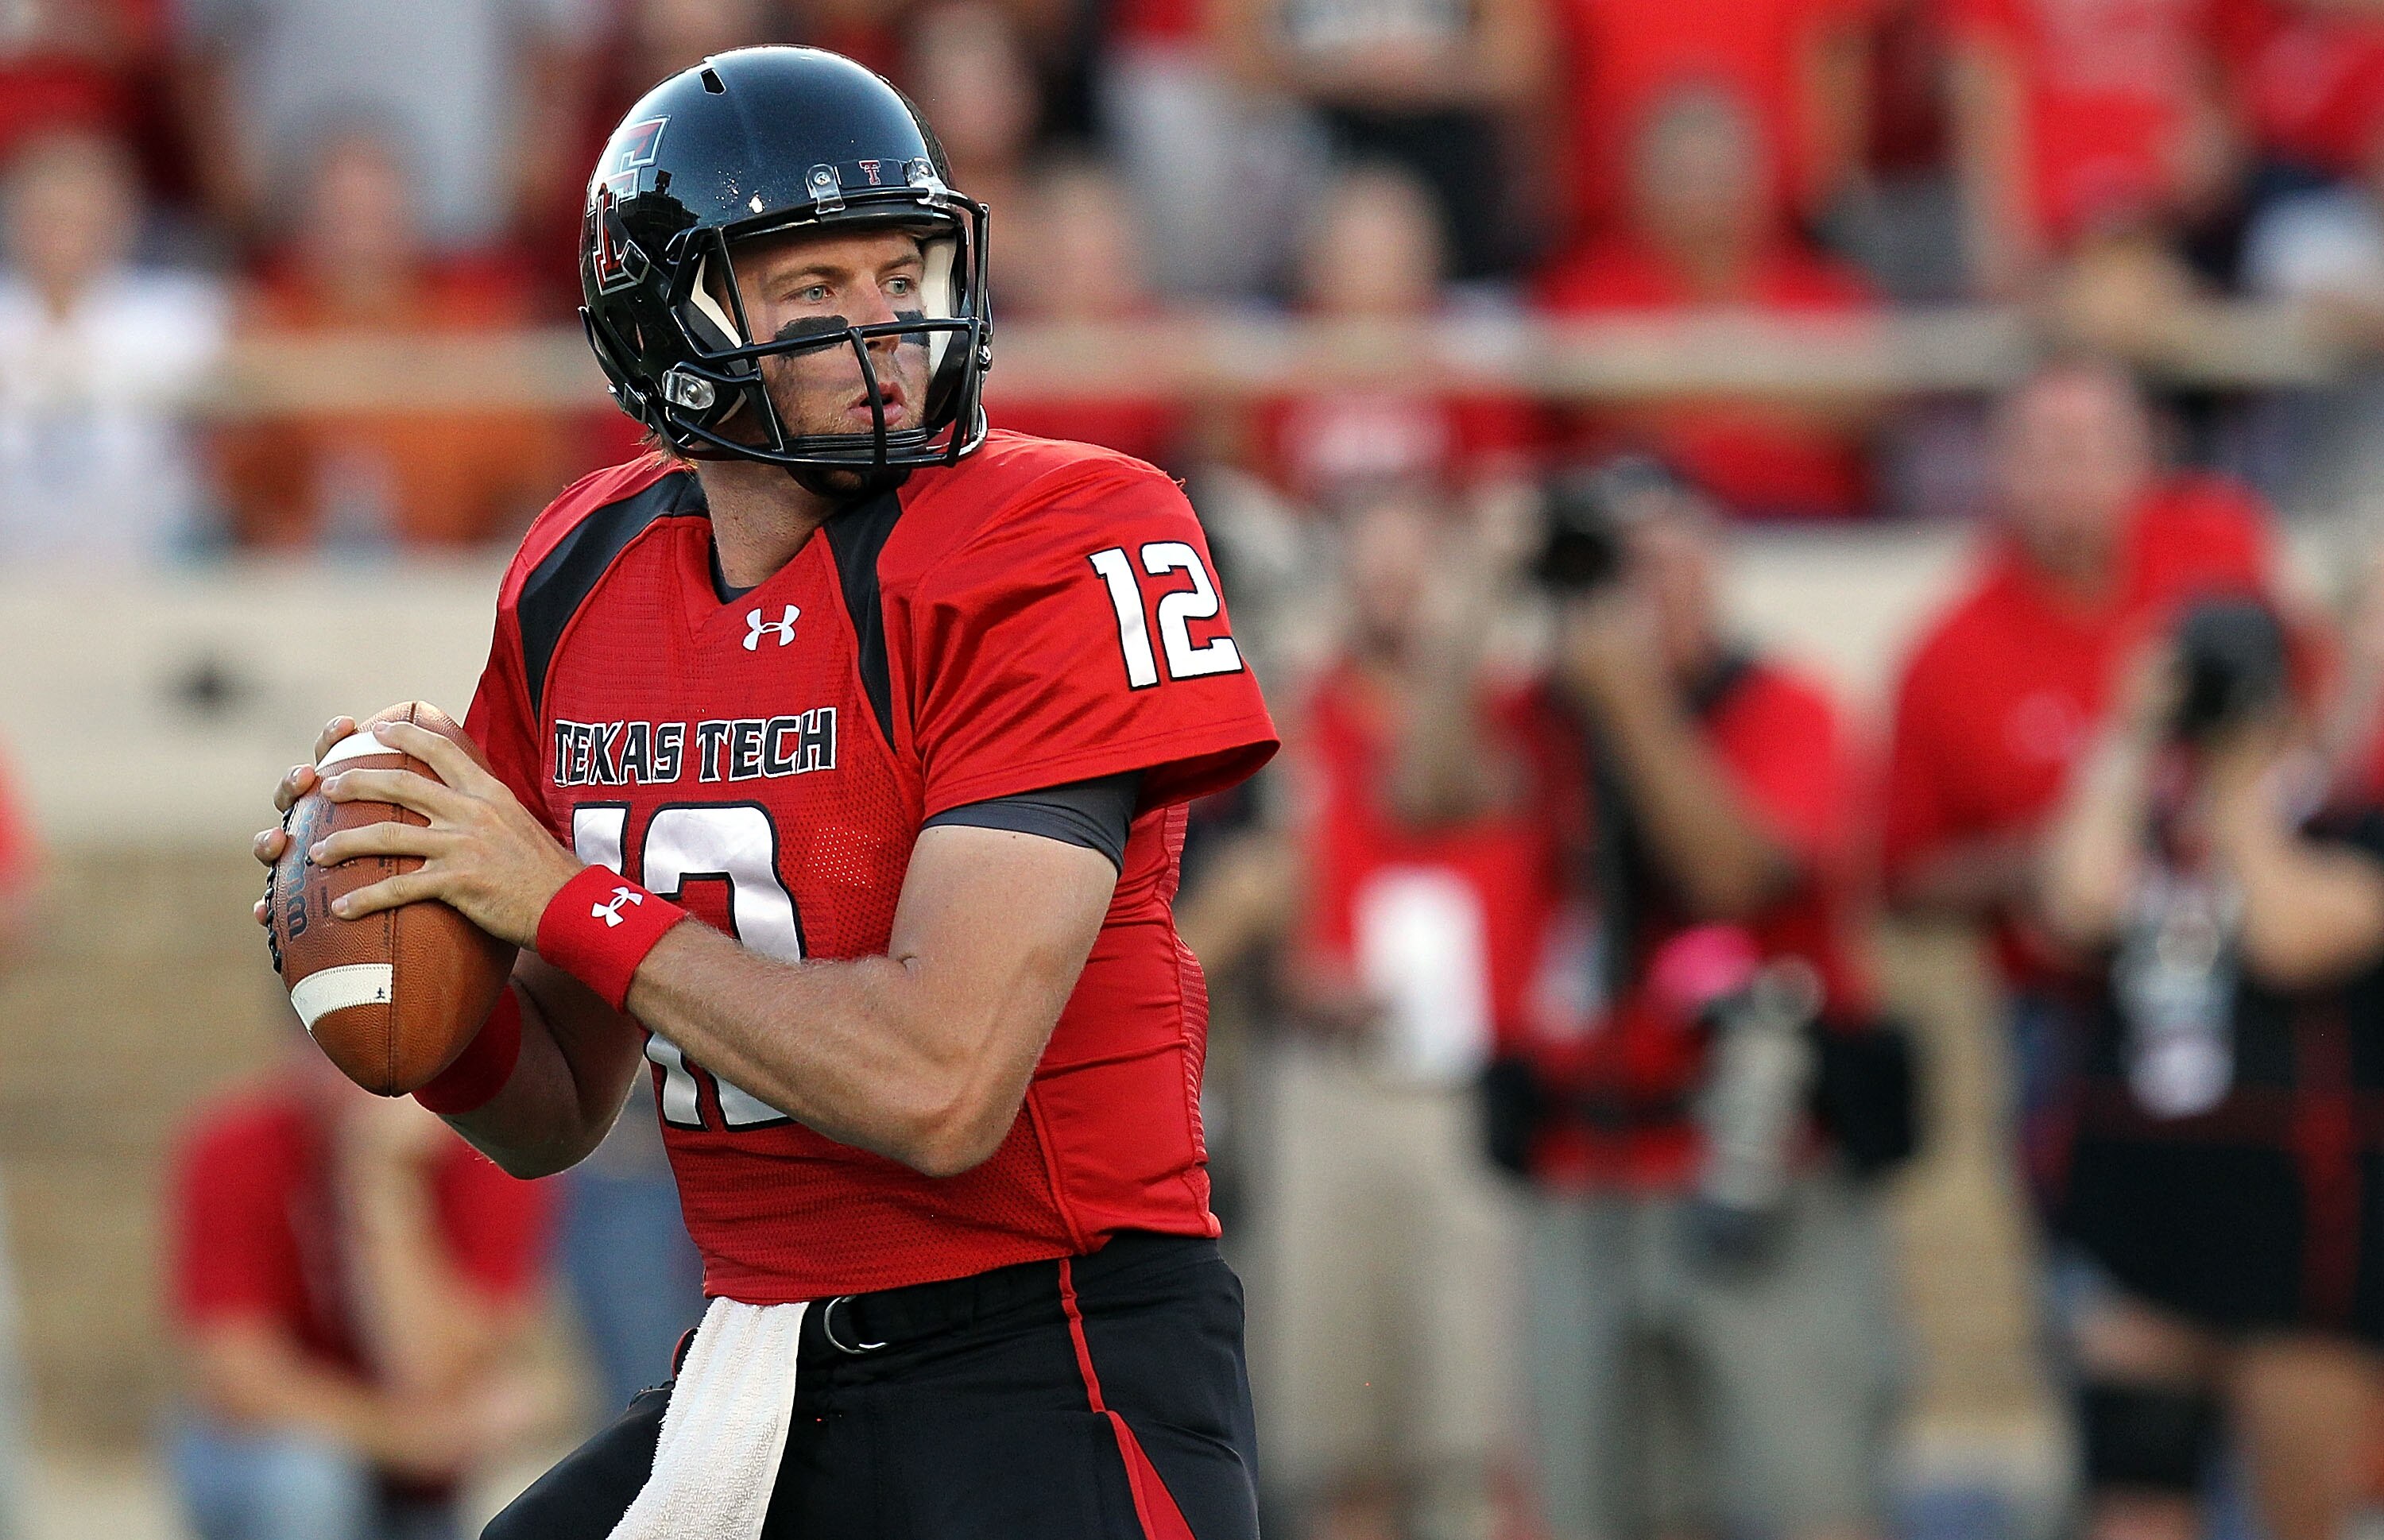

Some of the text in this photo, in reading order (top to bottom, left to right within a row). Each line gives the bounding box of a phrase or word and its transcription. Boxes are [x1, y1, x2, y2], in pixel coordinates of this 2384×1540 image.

[1086, 540, 1245, 691] 12
[553, 707, 837, 786] TEXAS TECH
